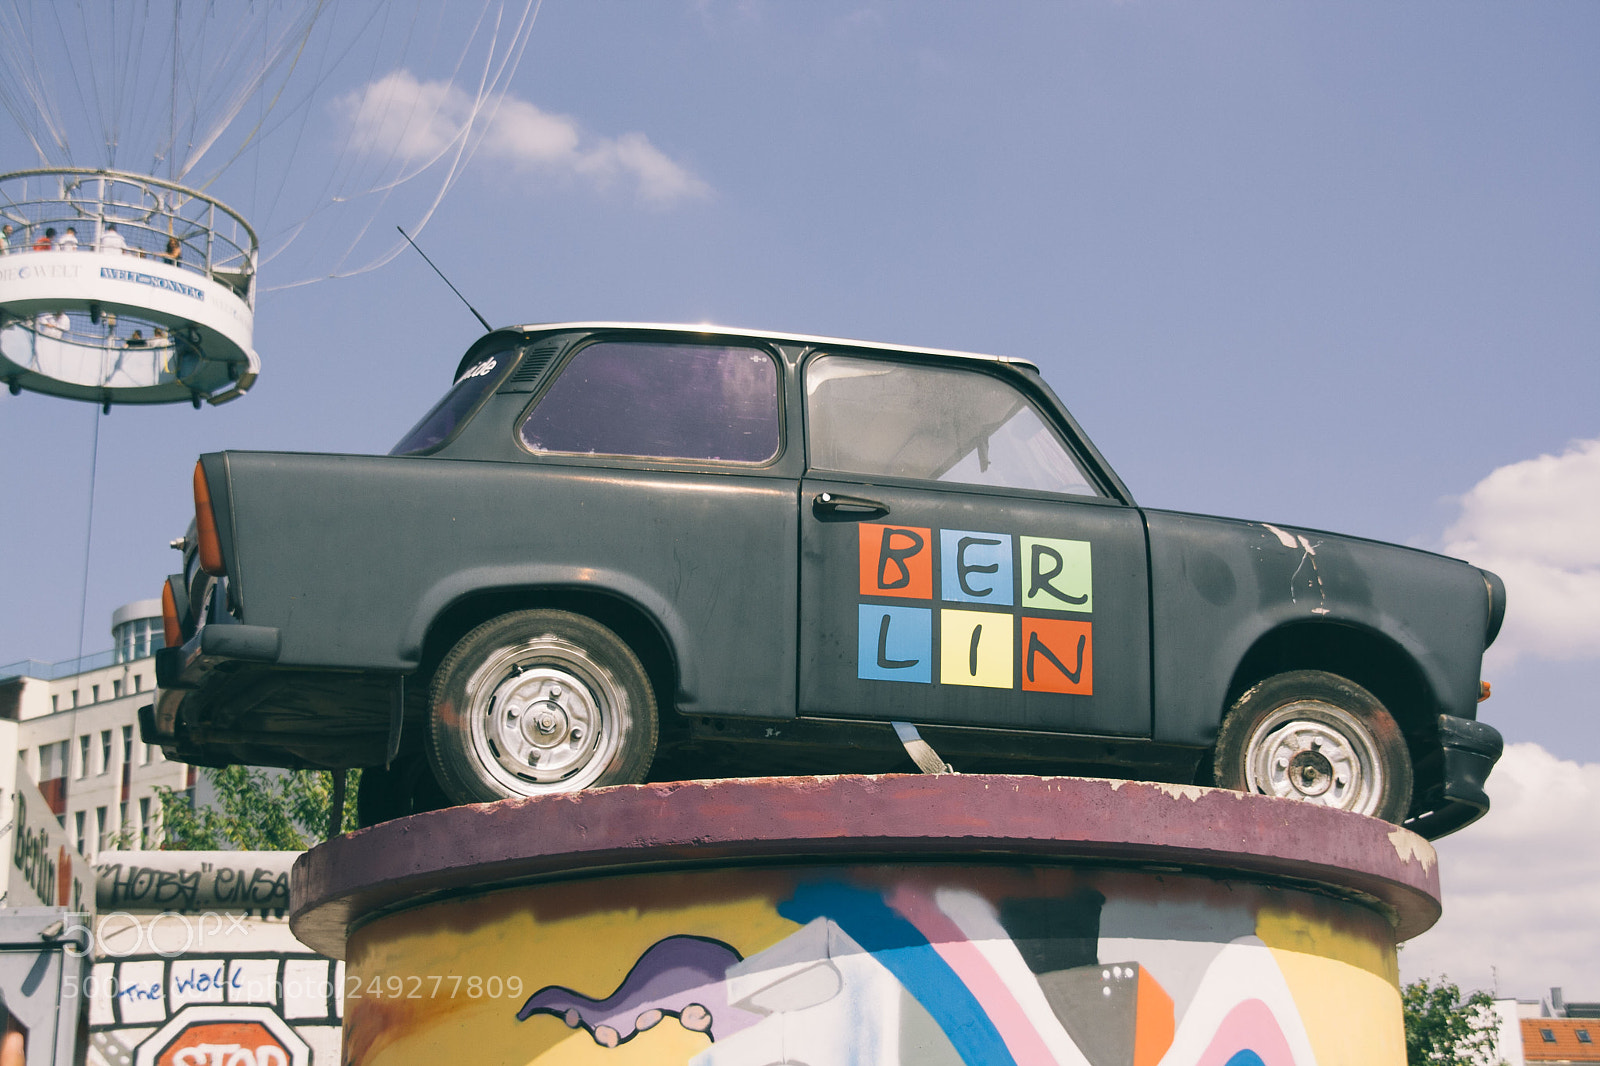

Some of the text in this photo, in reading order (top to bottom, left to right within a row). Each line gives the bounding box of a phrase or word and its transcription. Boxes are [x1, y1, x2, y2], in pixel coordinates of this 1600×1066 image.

[101, 267, 139, 284] WELT
[878, 528, 1088, 605] BER
[877, 614, 1086, 685] LIN
[117, 983, 161, 1003] The
